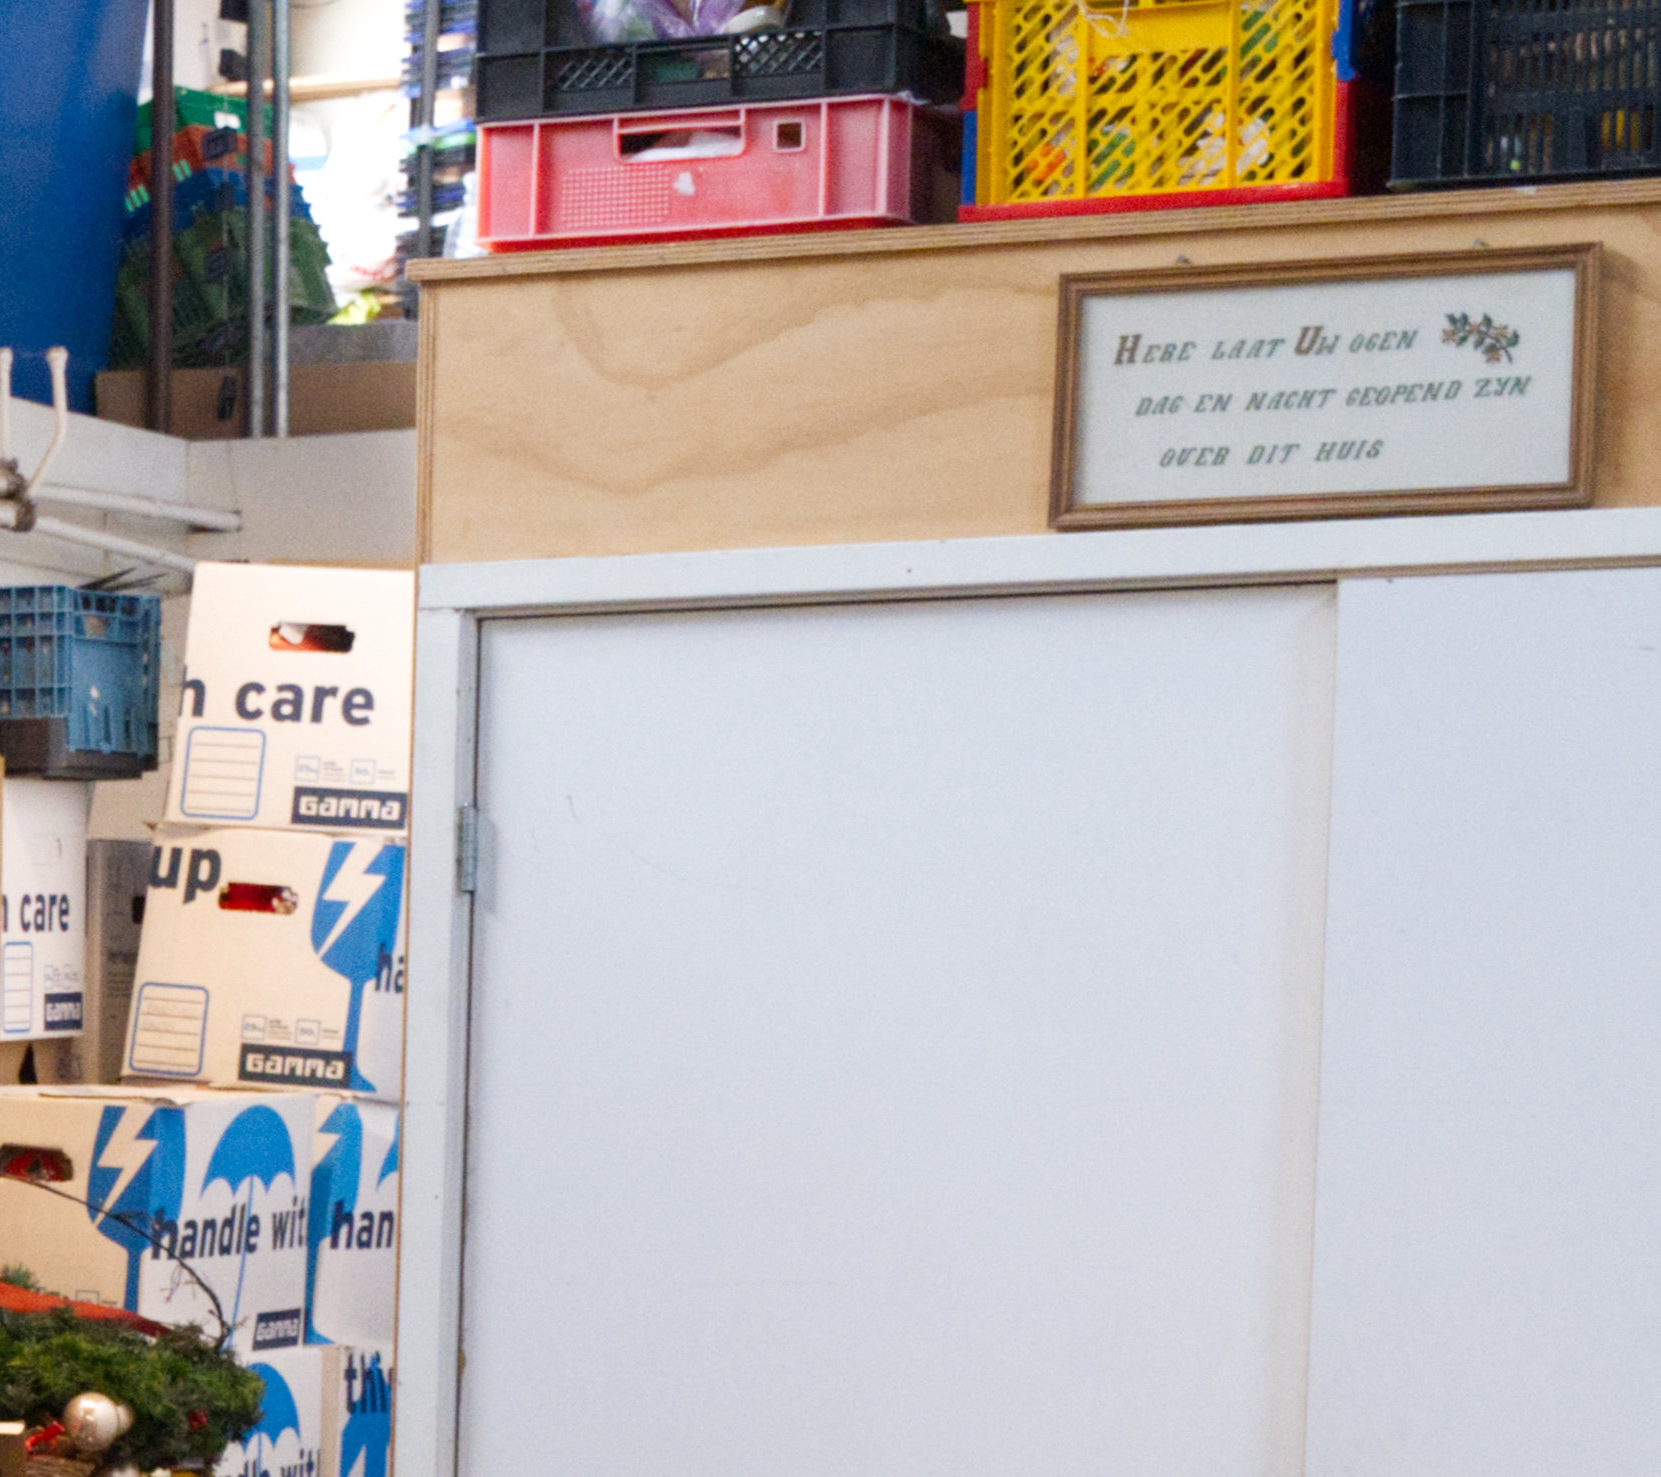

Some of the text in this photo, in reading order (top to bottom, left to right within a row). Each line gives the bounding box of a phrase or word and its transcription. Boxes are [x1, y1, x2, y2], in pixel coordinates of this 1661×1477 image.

[1210, 337, 1287, 361] LAAT
[1348, 329, 1419, 353] OGEN
[1133, 395, 1182, 417] DAG
[1193, 393, 1230, 415] EN
[1244, 389, 1338, 413] NACHT
[1344, 381, 1463, 408] GEOPEND
[1158, 439, 1385, 468] OVER DIT HUIS
[234, 679, 375, 727] care
[148, 845, 223, 905] up
[20, 892, 70, 933] care
[151, 1195, 307, 1261] handle wit
[329, 1200, 394, 1251] han
